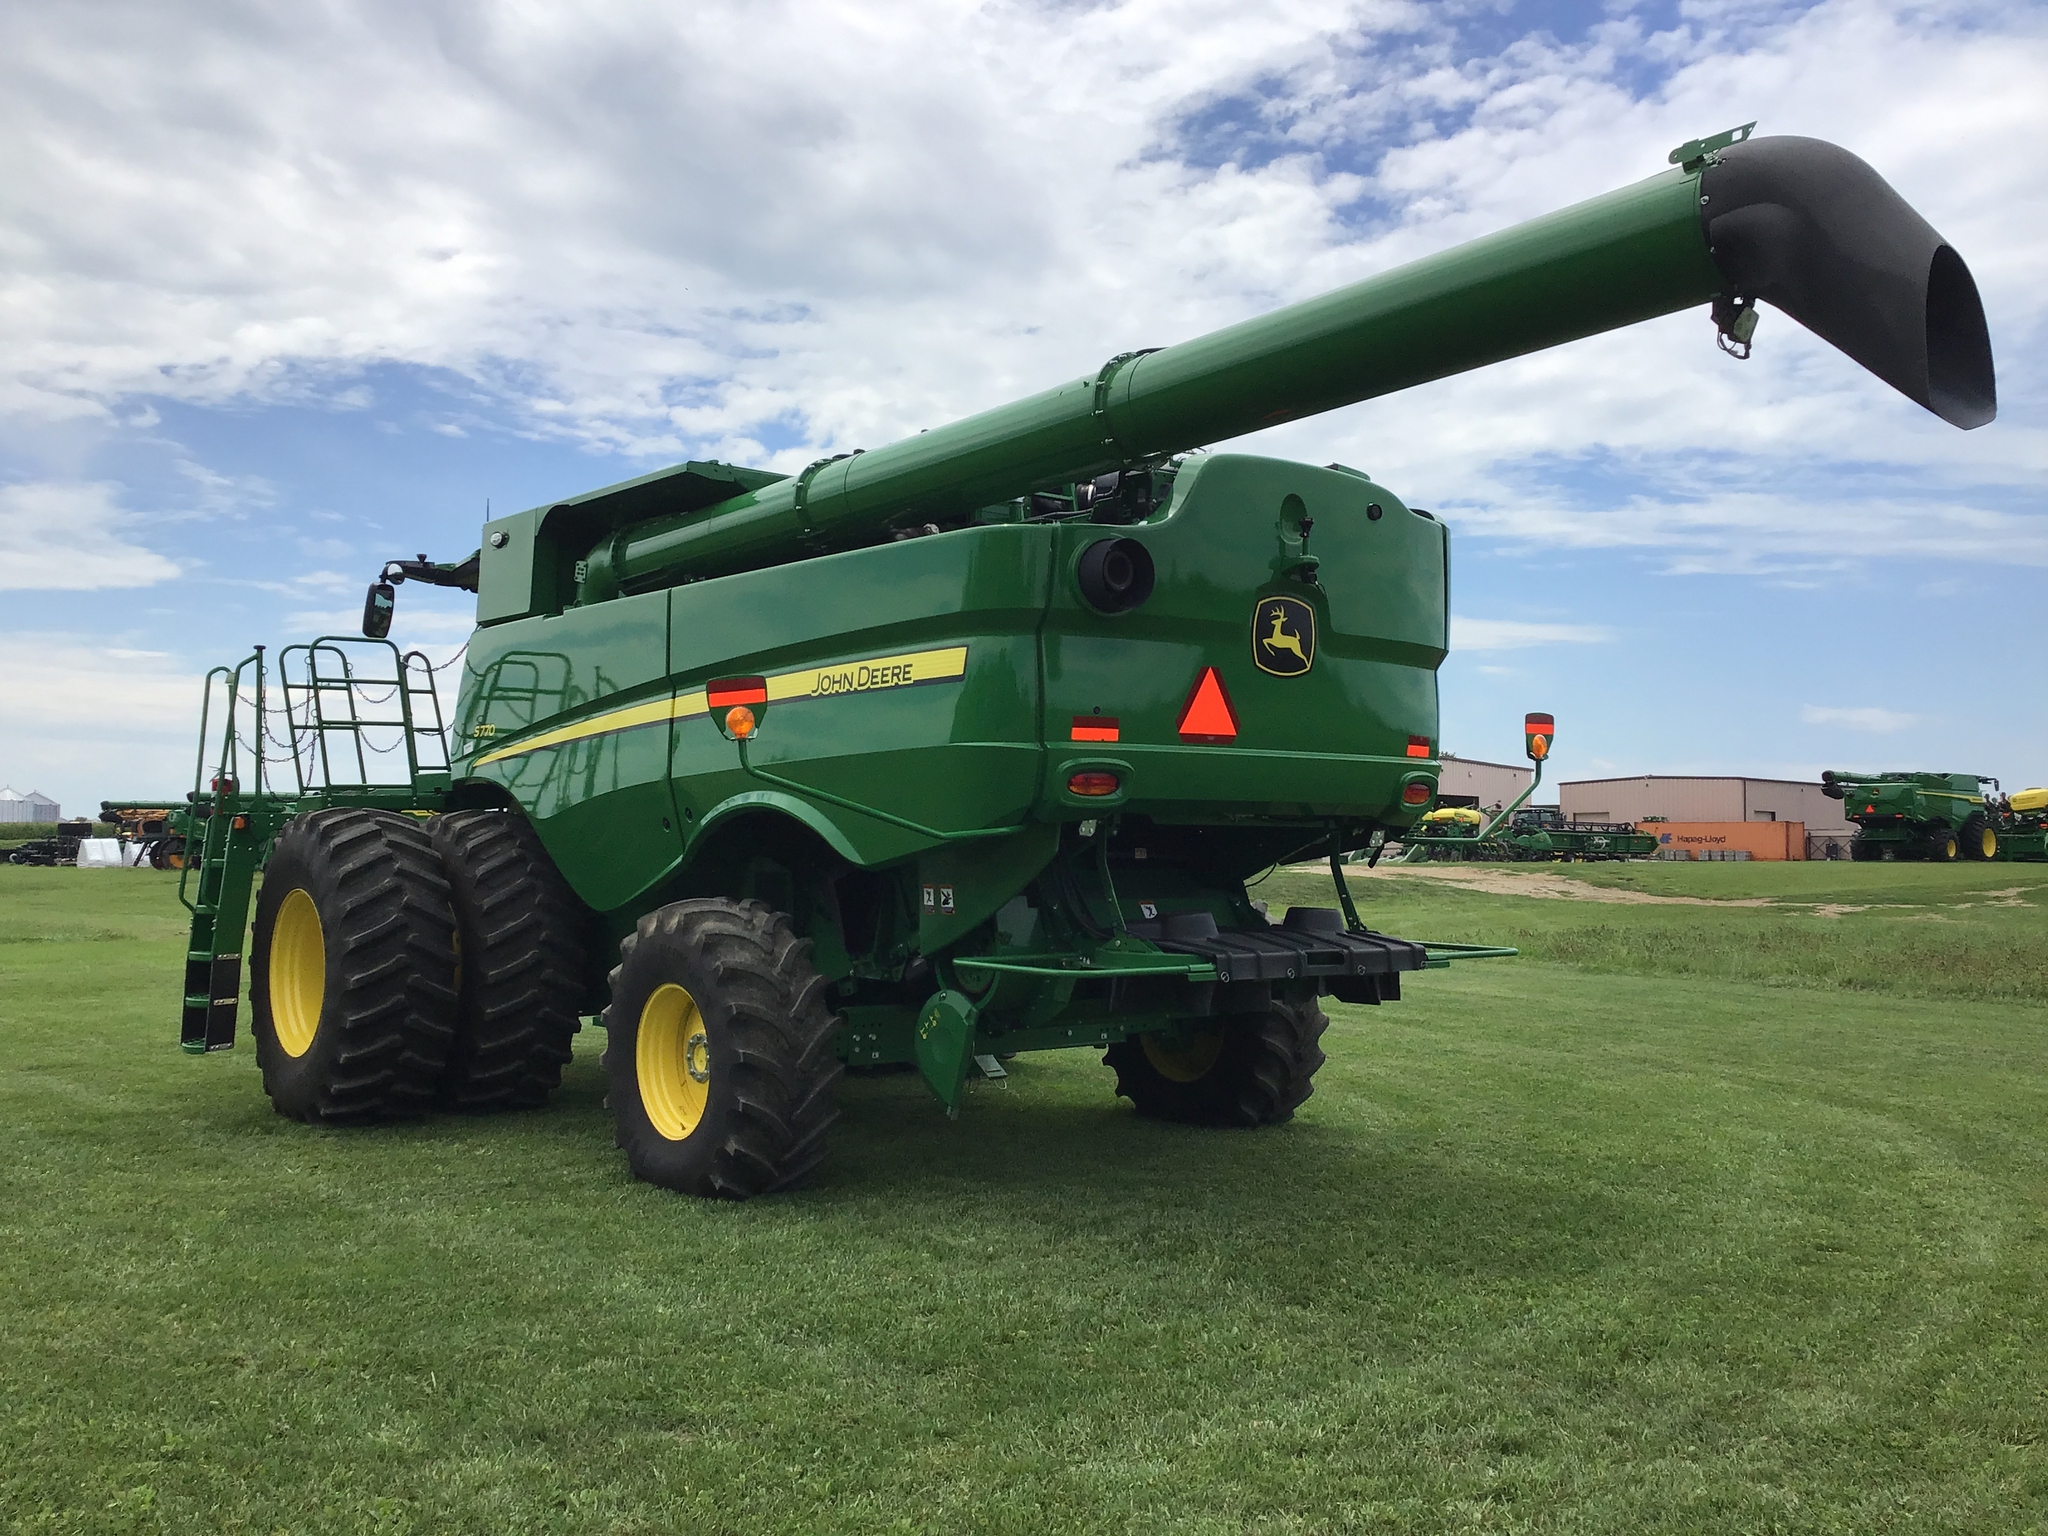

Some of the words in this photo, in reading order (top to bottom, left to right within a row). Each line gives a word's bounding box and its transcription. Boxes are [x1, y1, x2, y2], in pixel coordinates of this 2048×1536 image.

[811, 672, 854, 694] JOHN
[857, 664, 914, 687] DEERE
[473, 723, 496, 738] S770
[1677, 835, 1726, 845] Hapag-Lloyd
